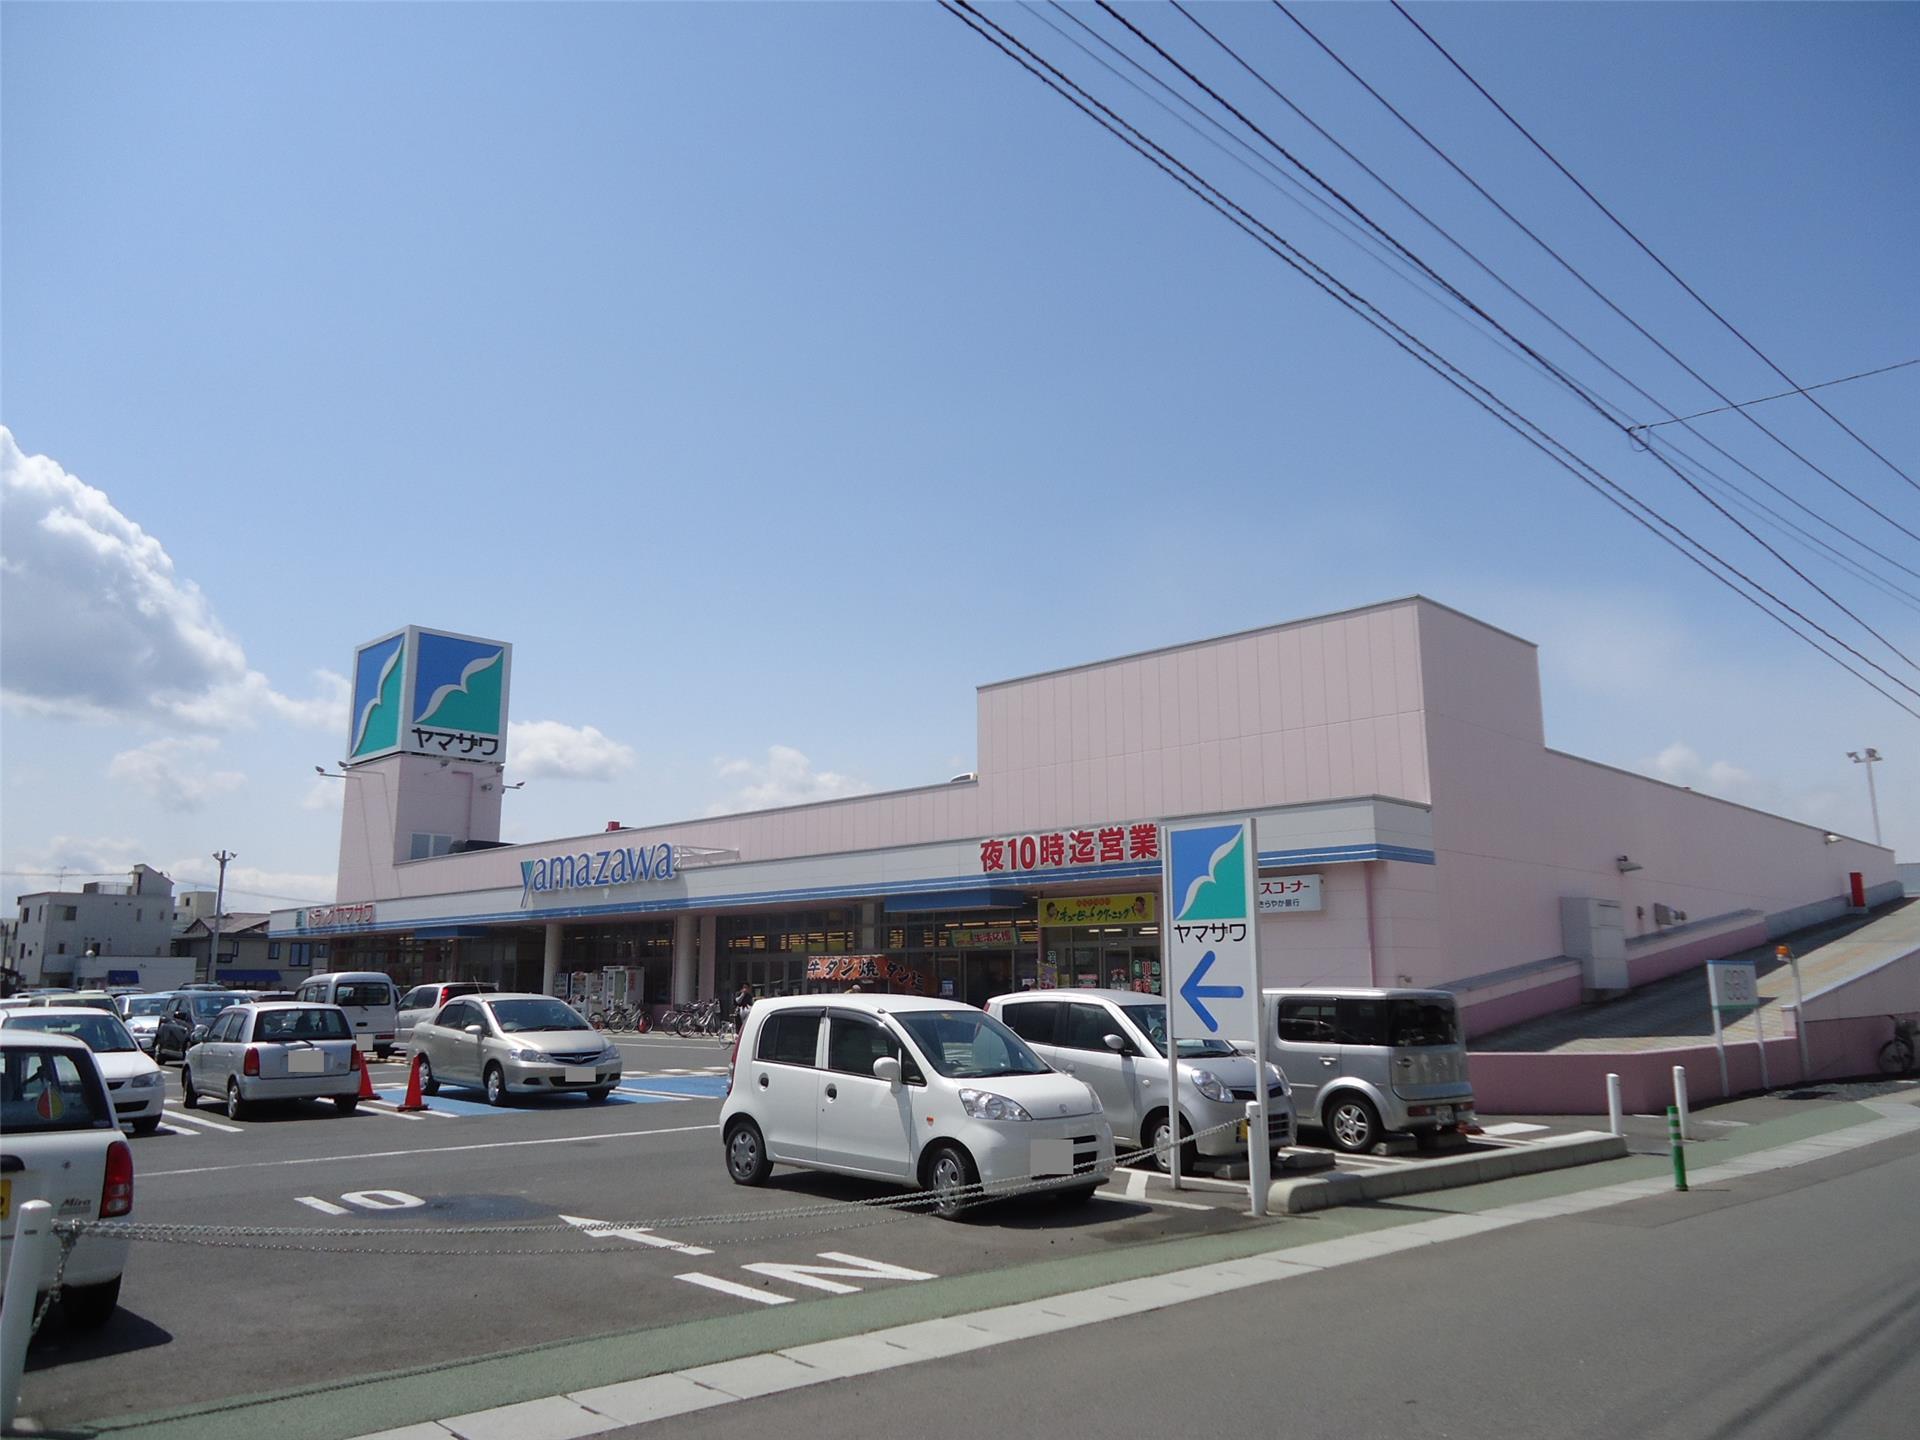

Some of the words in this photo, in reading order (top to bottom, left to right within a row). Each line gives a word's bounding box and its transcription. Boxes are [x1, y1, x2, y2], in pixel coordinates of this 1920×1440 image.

[980, 823, 1158, 872] 夜10時迄営業
[520, 843, 673, 908] yamazawa
[1174, 923, 1247, 943] ヤマザワ
[808, 959, 879, 977] 牛タン焼
[673, 1252, 939, 1305] IN
